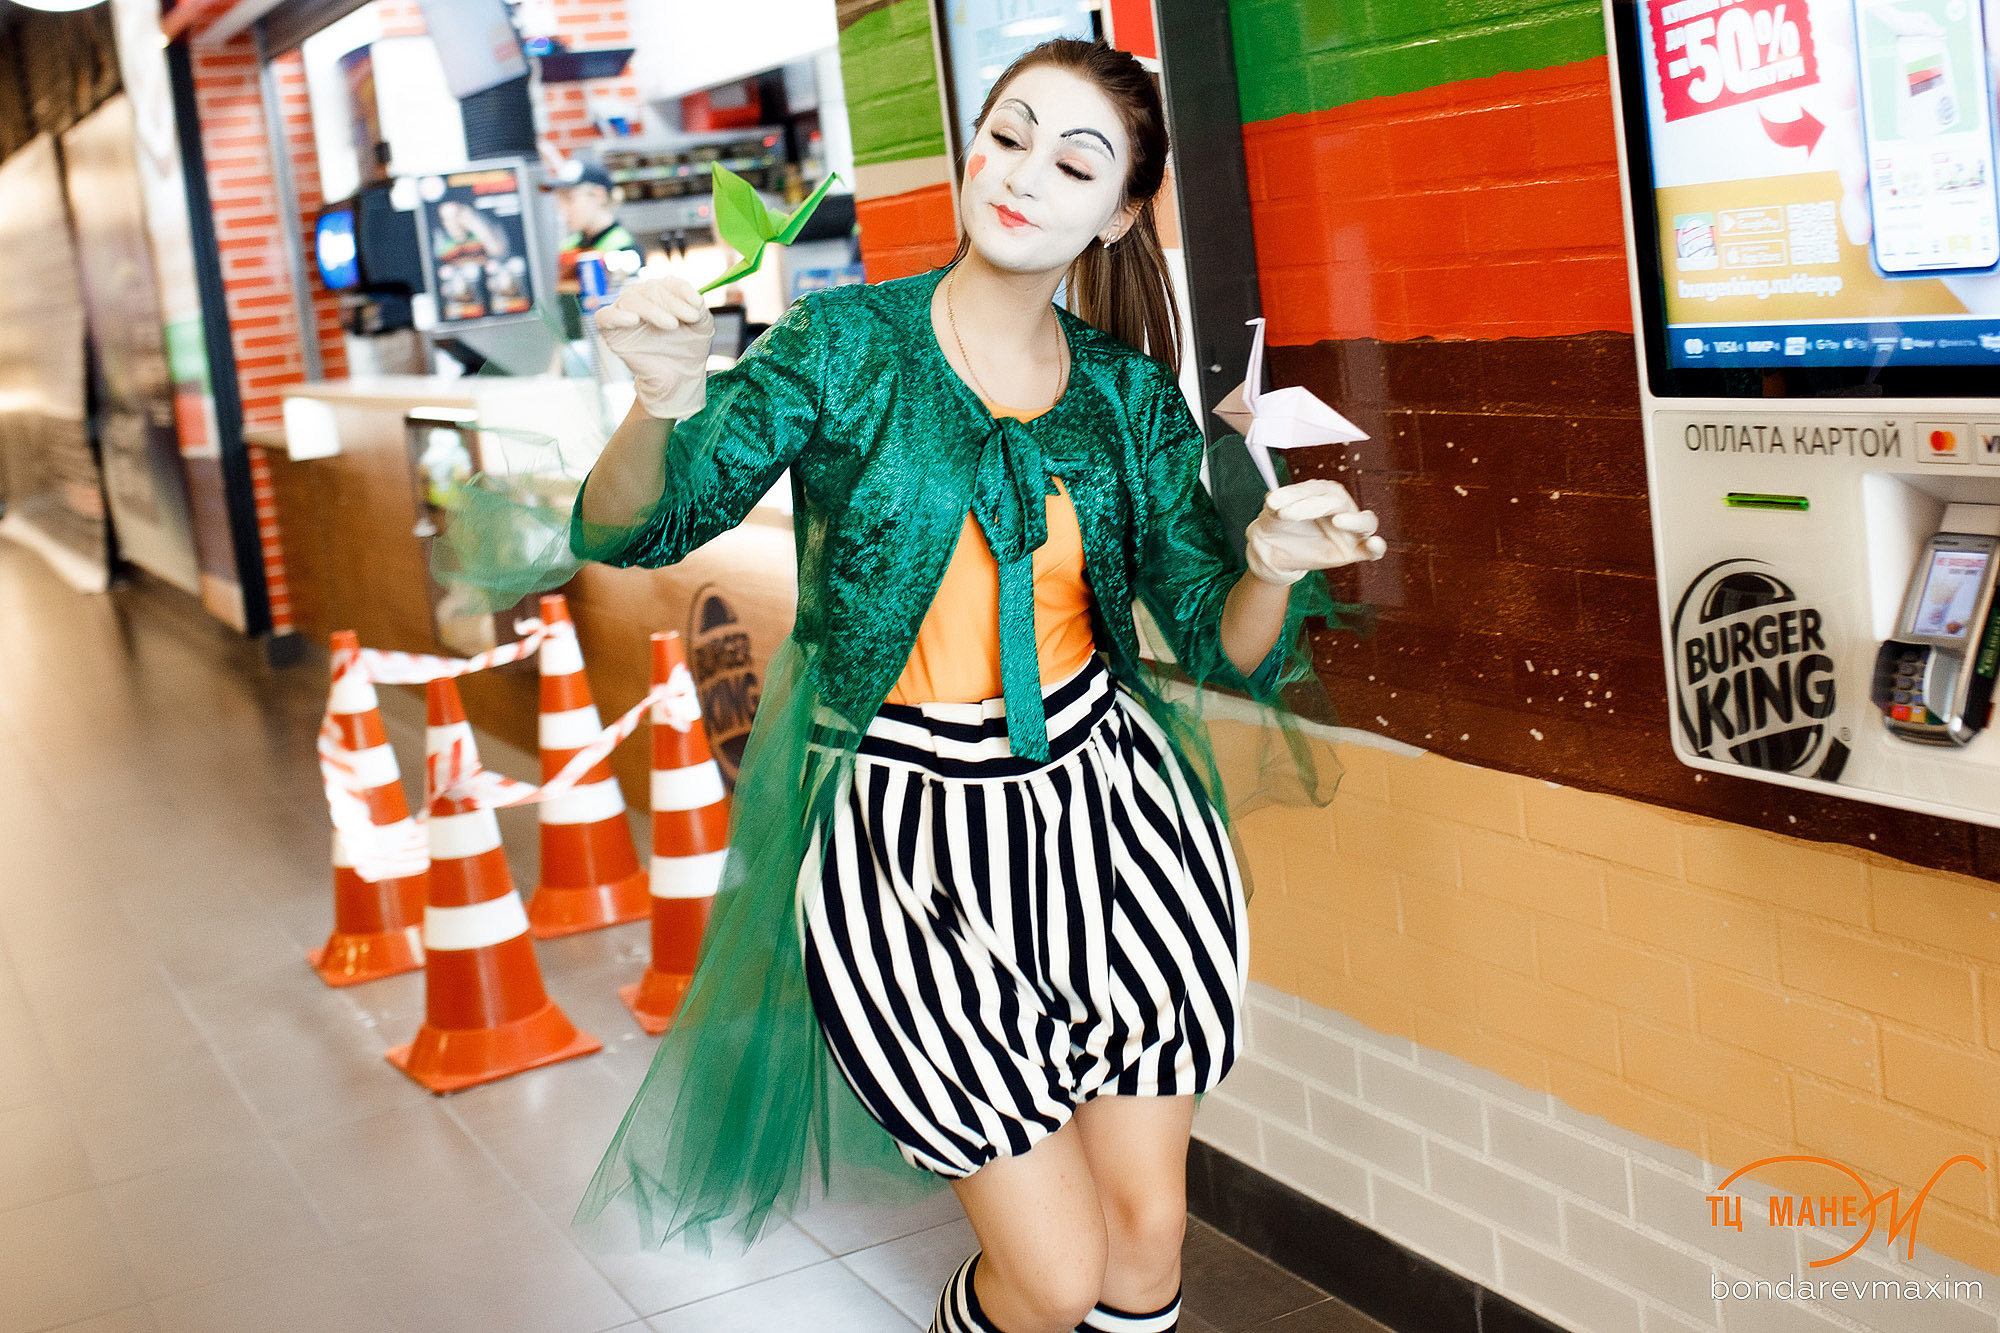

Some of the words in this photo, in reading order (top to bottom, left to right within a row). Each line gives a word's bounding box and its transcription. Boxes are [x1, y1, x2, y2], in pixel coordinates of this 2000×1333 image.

[1668, 4, 1802, 104] -50%
[1684, 423, 1788, 455] ОПЛАТА
[1792, 420, 1902, 458] КАРТОЙ
[1685, 608, 1826, 686] BURGER
[1696, 653, 1837, 750] KING
